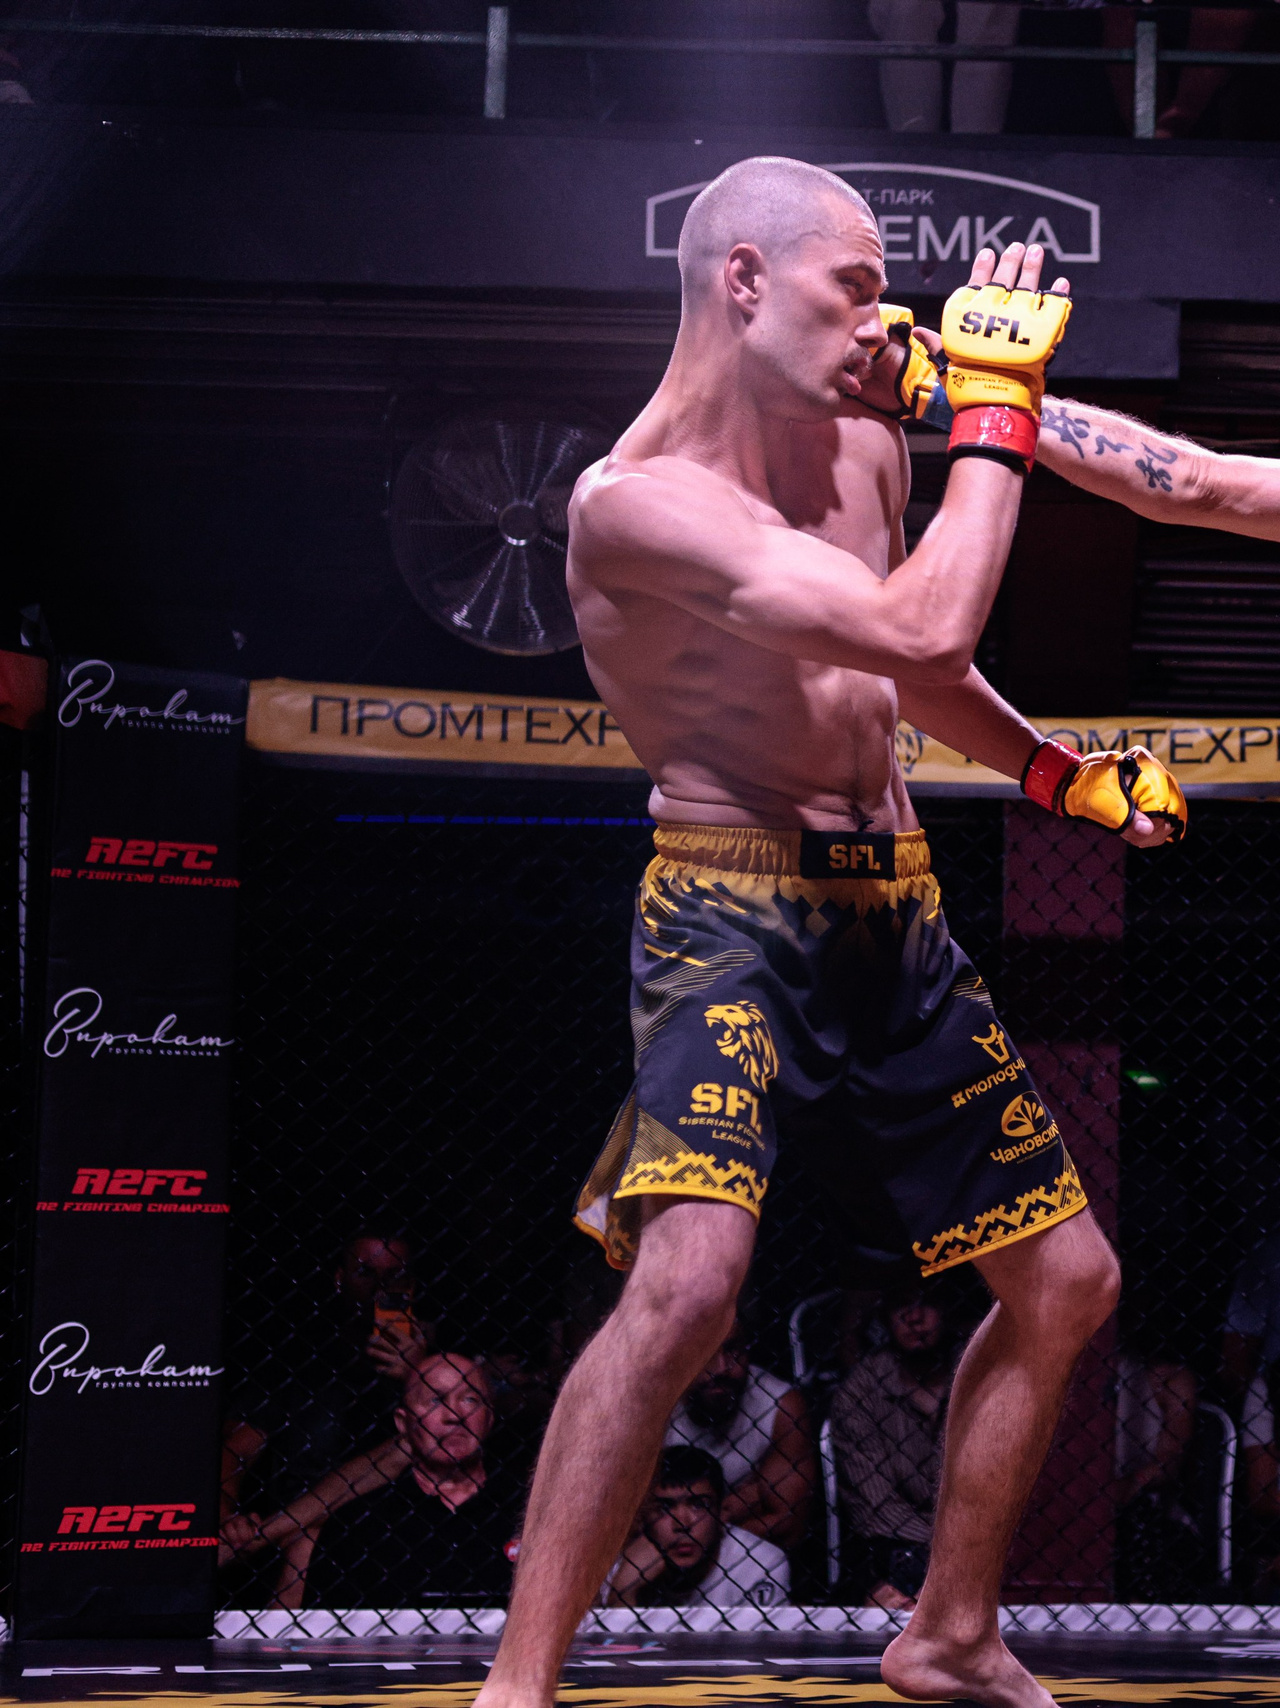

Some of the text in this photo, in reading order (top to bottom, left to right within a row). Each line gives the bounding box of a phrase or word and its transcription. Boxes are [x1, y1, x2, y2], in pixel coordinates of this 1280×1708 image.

[959, 311, 1031, 346] SFL
[829, 844, 881, 870] SFL
[77, 870, 155, 883] FIGHTING
[690, 1083, 762, 1135] SFL
[678, 1116, 735, 1129] SIBERIAN
[711, 1129, 753, 1150] LEAGUE
[63, 1202, 143, 1212] FIGHTING
[147, 1203, 230, 1213] CHAMPION
[48, 1540, 130, 1552] FIGHTING
[134, 1537, 220, 1549] CHAMPION
